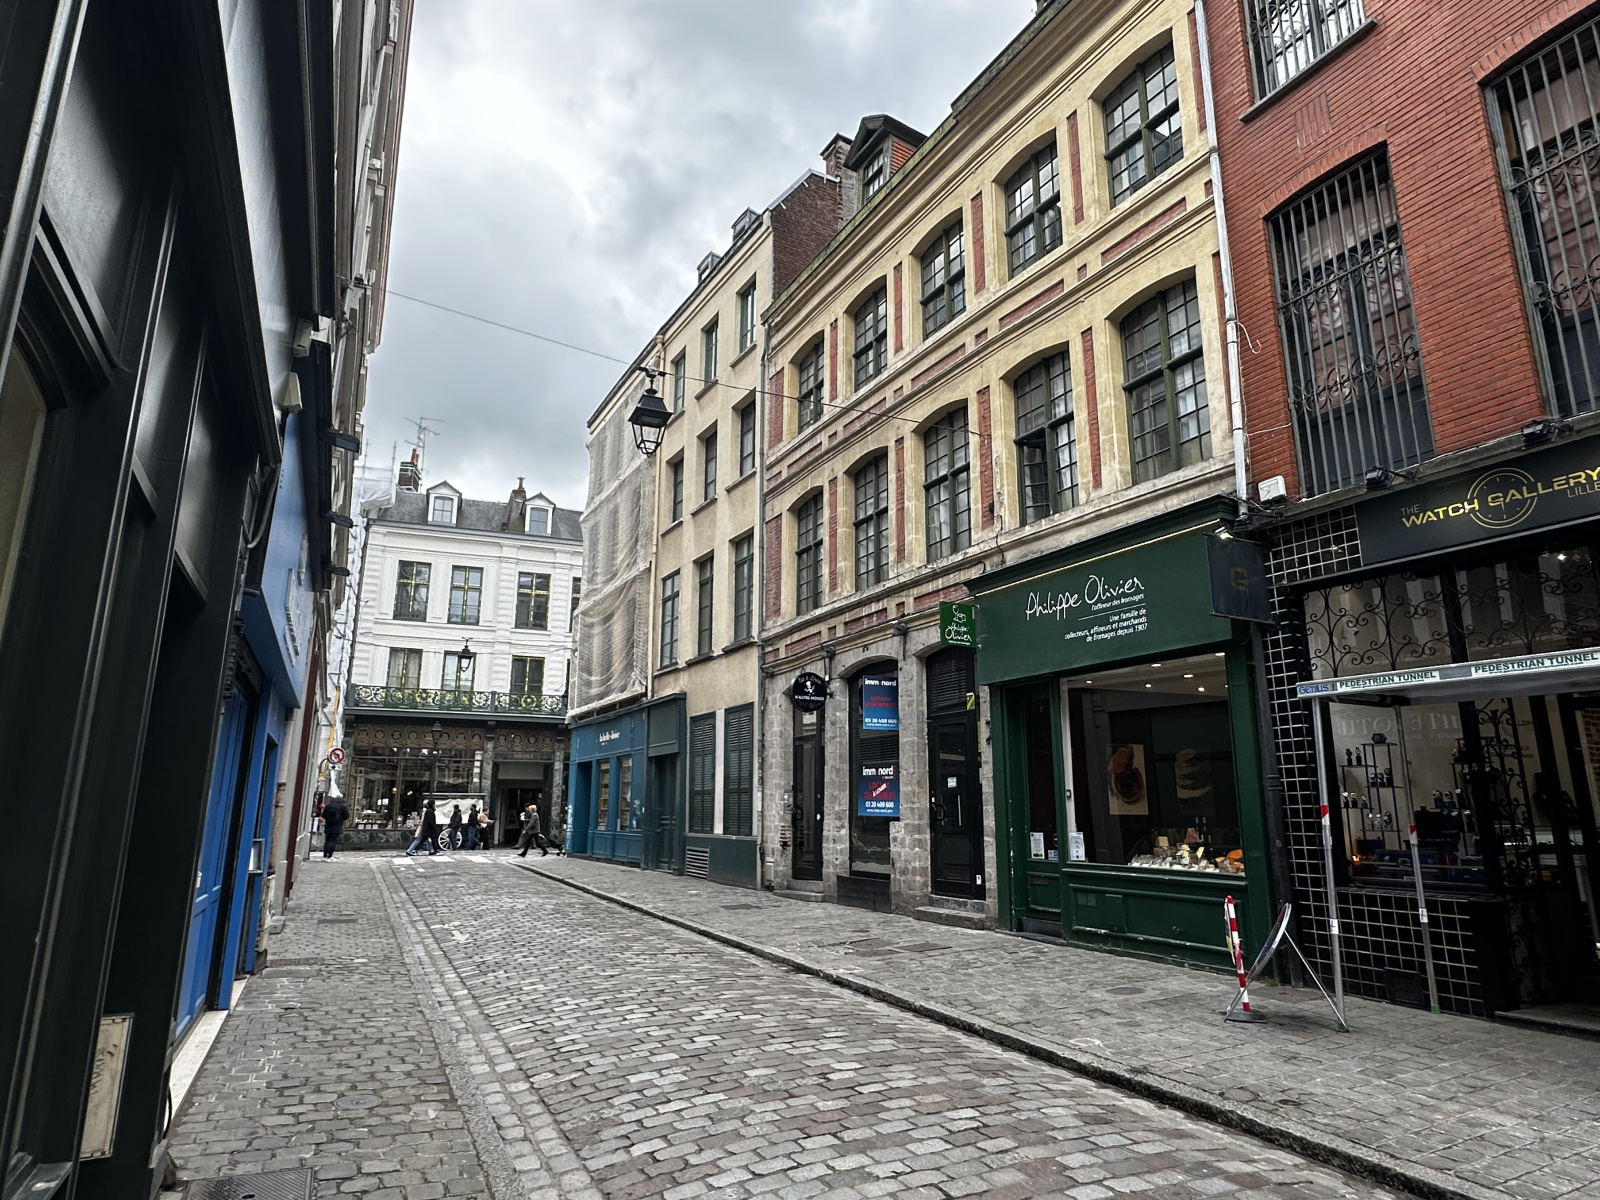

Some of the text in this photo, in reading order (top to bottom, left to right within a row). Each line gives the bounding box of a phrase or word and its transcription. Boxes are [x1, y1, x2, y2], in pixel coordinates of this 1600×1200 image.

[1402, 466, 1600, 528] WATCH GALLERY
[1567, 482, 1600, 498] LILLE
[1400, 504, 1420, 516] THE
[1025, 575, 1145, 621] Philippe Olivier
[1121, 593, 1145, 604] fromages
[1109, 608, 1147, 622] Une famille de
[1090, 625, 1111, 635] affineurs
[1119, 615, 1147, 627] marchands
[1093, 630, 1116, 640] fromages
[1117, 627, 1134, 636] depuis
[1135, 623, 1148, 632] 1907
[945, 627, 972, 642] Olivier
[1474, 659, 1545, 674] PEDESTRIAN
[1548, 652, 1599, 666] TUNNEL
[1339, 675, 1397, 688] PEDESTRIAN
[1397, 671, 1437, 682] TUNNEL
